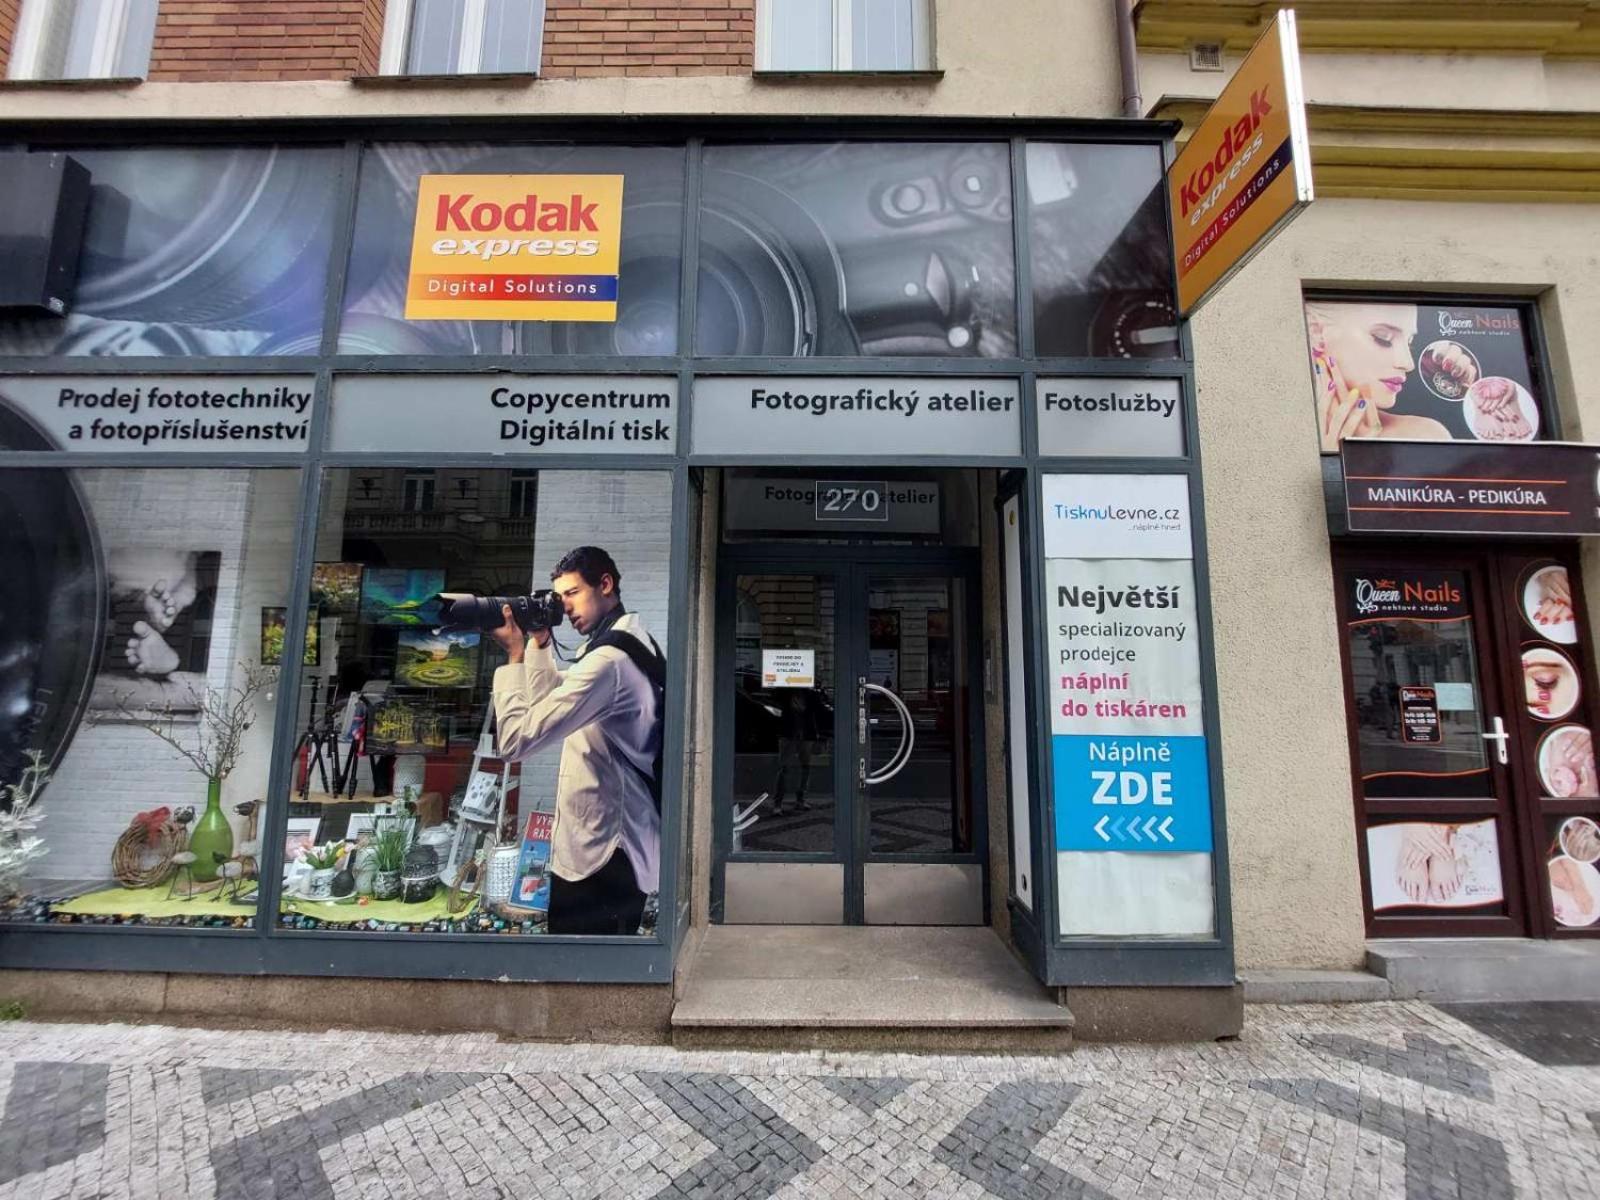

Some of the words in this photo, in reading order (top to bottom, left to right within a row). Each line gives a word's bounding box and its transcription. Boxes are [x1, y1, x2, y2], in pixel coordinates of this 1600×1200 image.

[1180, 84, 1273, 219] Kodak
[1190, 132, 1264, 227] express
[435, 194, 599, 232] Kodak
[1185, 224, 1218, 267] Digital
[1222, 158, 1280, 226] Solutions
[432, 238, 600, 261] express
[428, 279, 494, 295] Digital
[505, 280, 597, 294] Solutions
[1438, 310, 1473, 336] Queen
[1476, 314, 1520, 329] Nails
[58, 387, 140, 415] Prodej
[147, 387, 311, 414] fototechniky
[490, 388, 671, 415] Copycentrum
[751, 389, 919, 416] Fotografický
[927, 389, 1014, 412] atelier
[1045, 392, 1176, 417] Fotoslužby
[69, 423, 82, 440] a
[90, 416, 307, 446] fotopříslušenství
[500, 418, 616, 446] Digitální
[622, 419, 671, 442] tisk
[824, 488, 879, 511] 270
[1368, 485, 1455, 503] MANIKÚRA
[1468, 487, 1547, 505] PEDIKÚRA
[1058, 585, 1181, 614] Největší
[1356, 578, 1401, 614] Queen
[1404, 581, 1461, 602] Nails
[1059, 622, 1186, 640] specializovaný
[1060, 646, 1136, 665] prodejce
[1061, 672, 1130, 695] náplní
[1061, 700, 1087, 717] do
[1095, 700, 1187, 718] tiskáren
[1089, 742, 1171, 766] Náplně
[1091, 771, 1173, 805] ZDE
